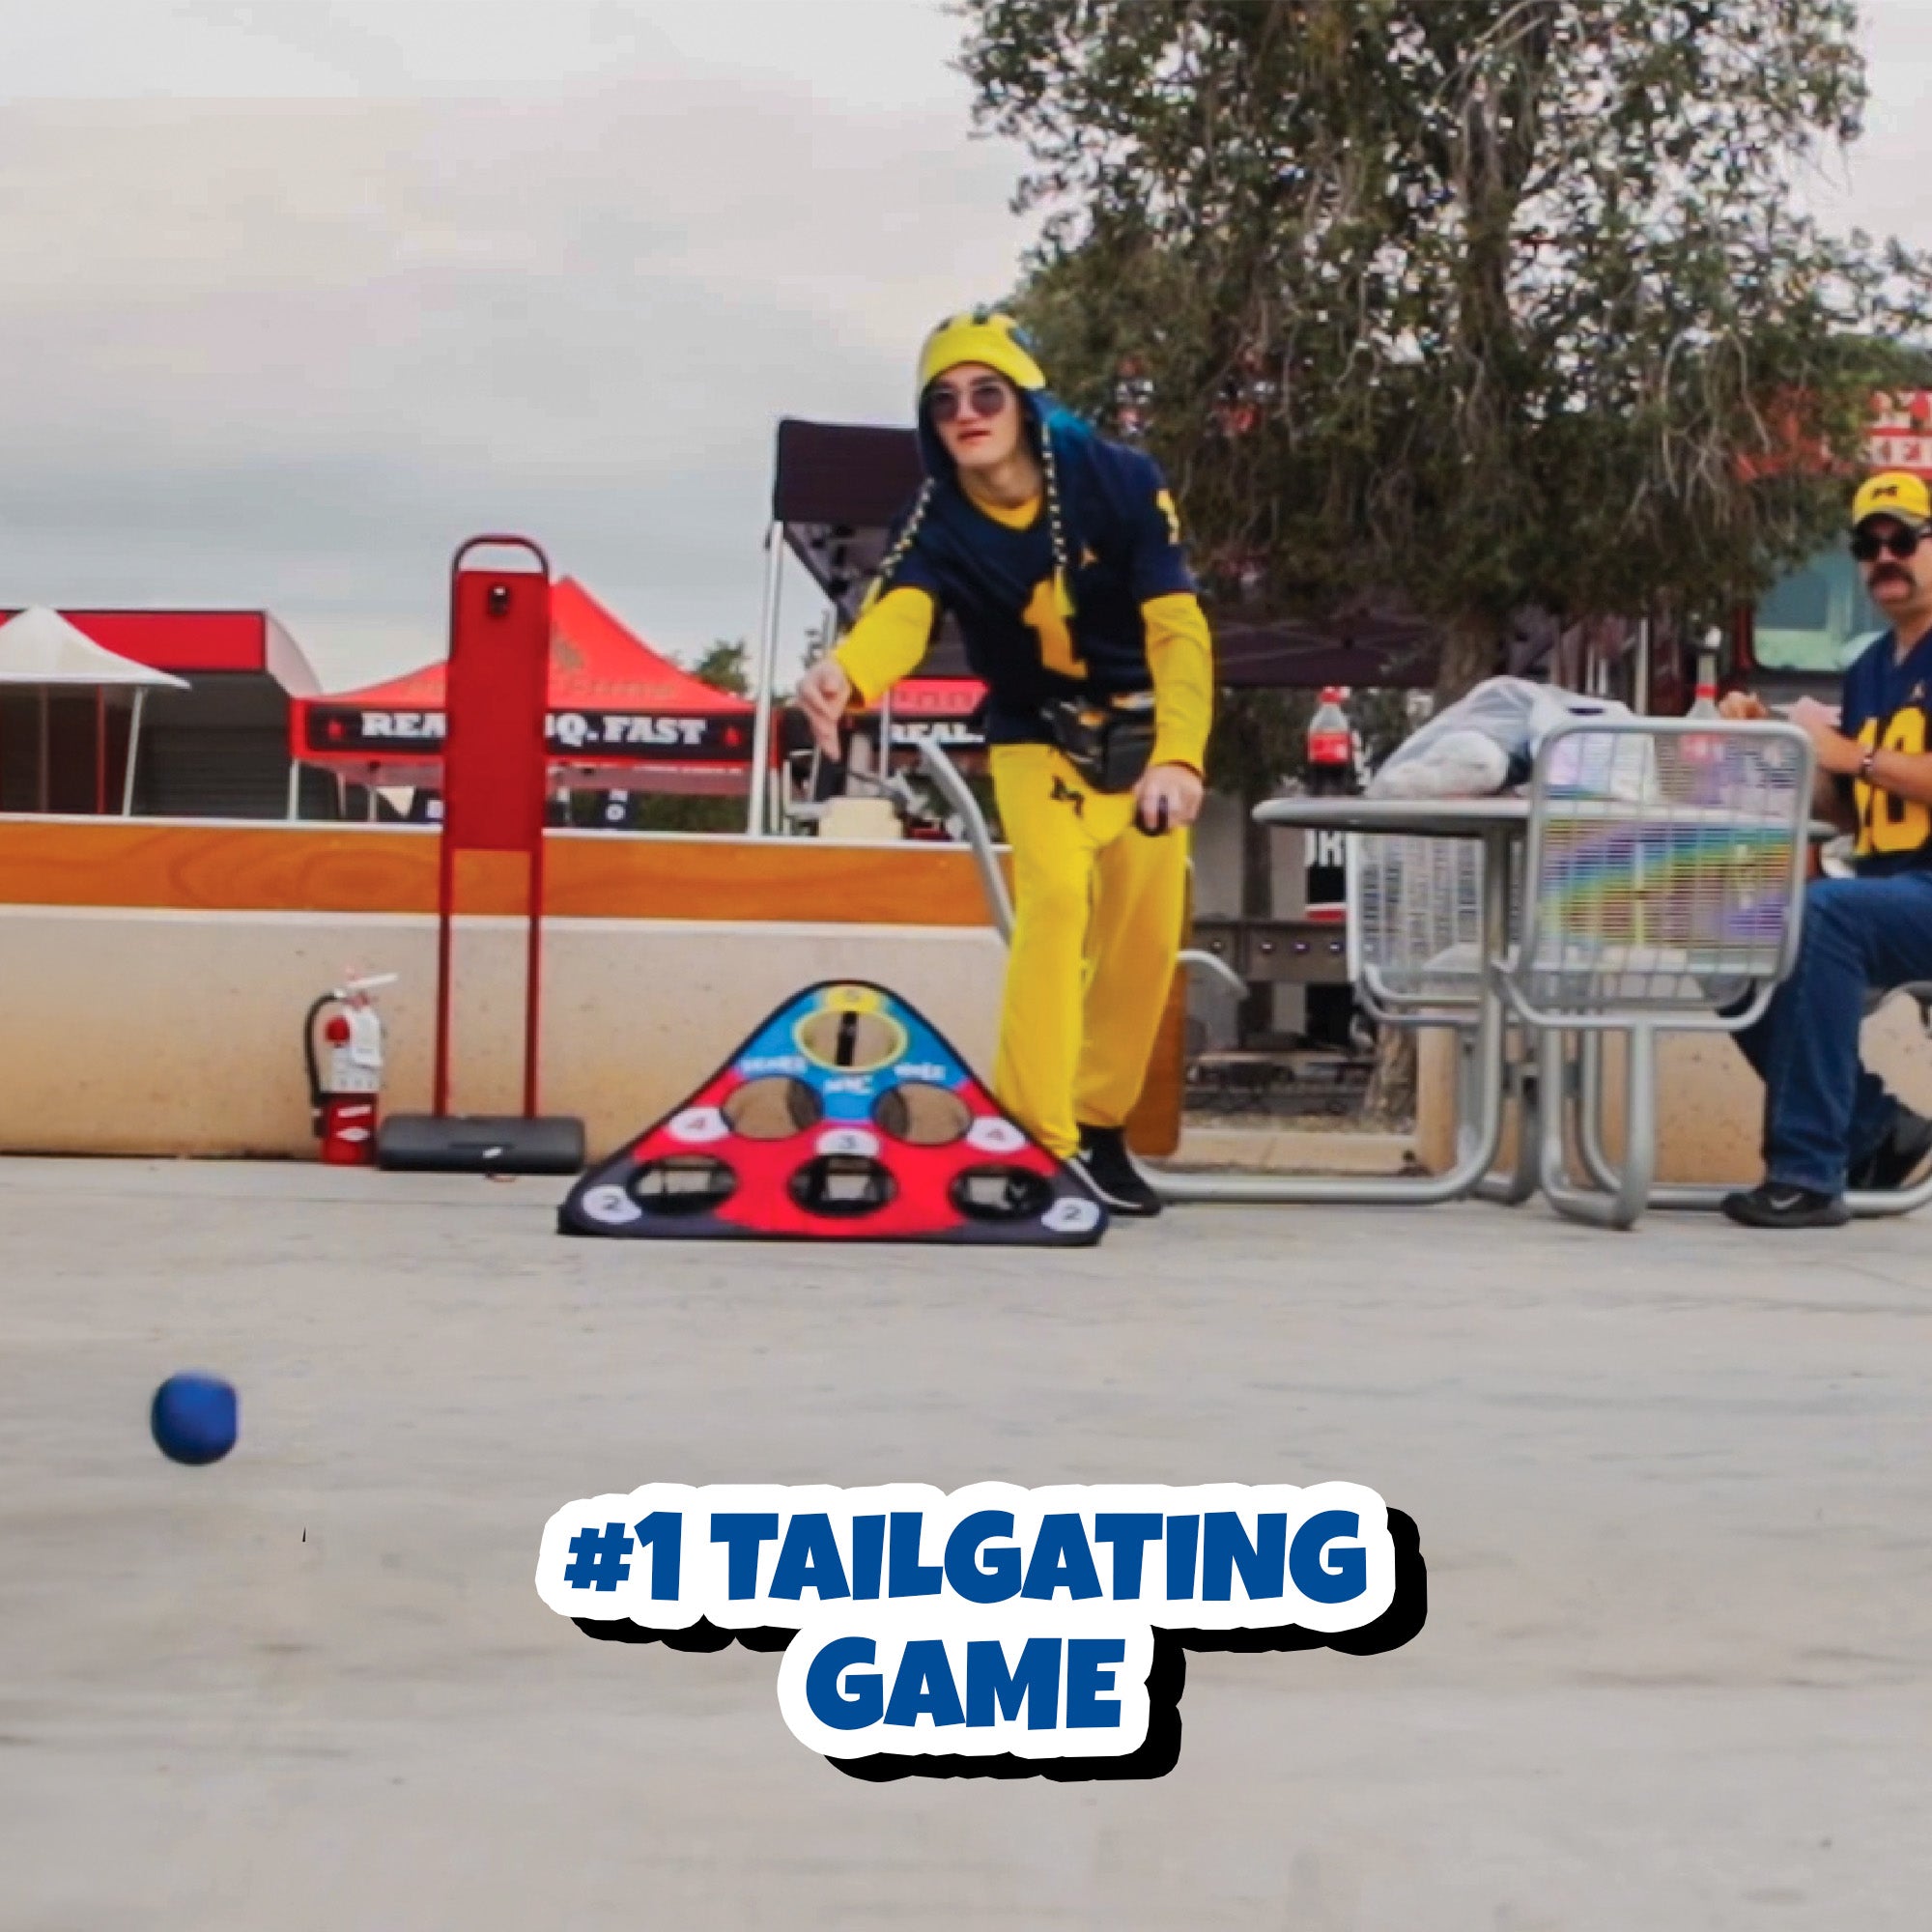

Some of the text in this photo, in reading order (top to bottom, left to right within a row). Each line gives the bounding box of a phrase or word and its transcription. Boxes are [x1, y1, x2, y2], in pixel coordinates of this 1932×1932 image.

[1023, 578, 1088, 679] 1
[362, 712, 445, 737] REA
[603, 715, 707, 745] FAST
